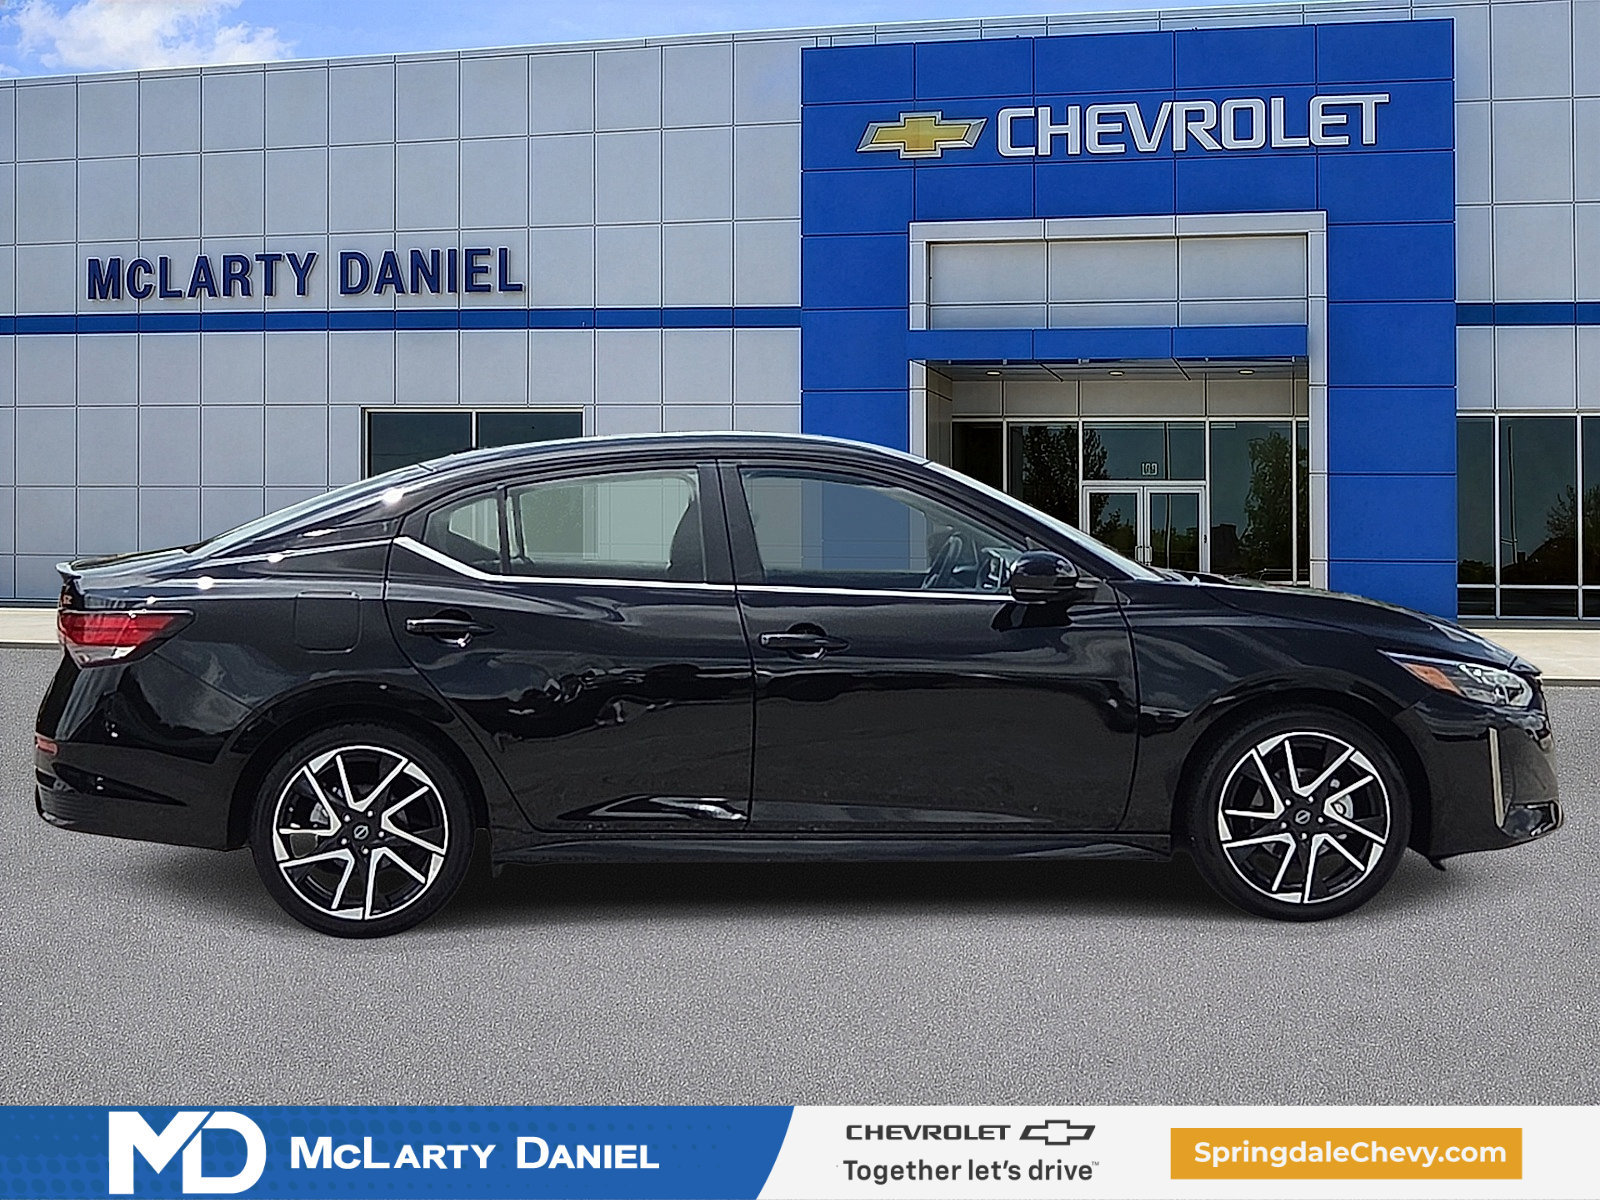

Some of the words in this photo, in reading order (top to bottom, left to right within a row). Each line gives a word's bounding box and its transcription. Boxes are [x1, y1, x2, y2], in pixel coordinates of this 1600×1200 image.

[997, 93, 1390, 157] CHEVROLET
[87, 252, 315, 300] MCLARTY
[339, 247, 525, 295] DANIEL
